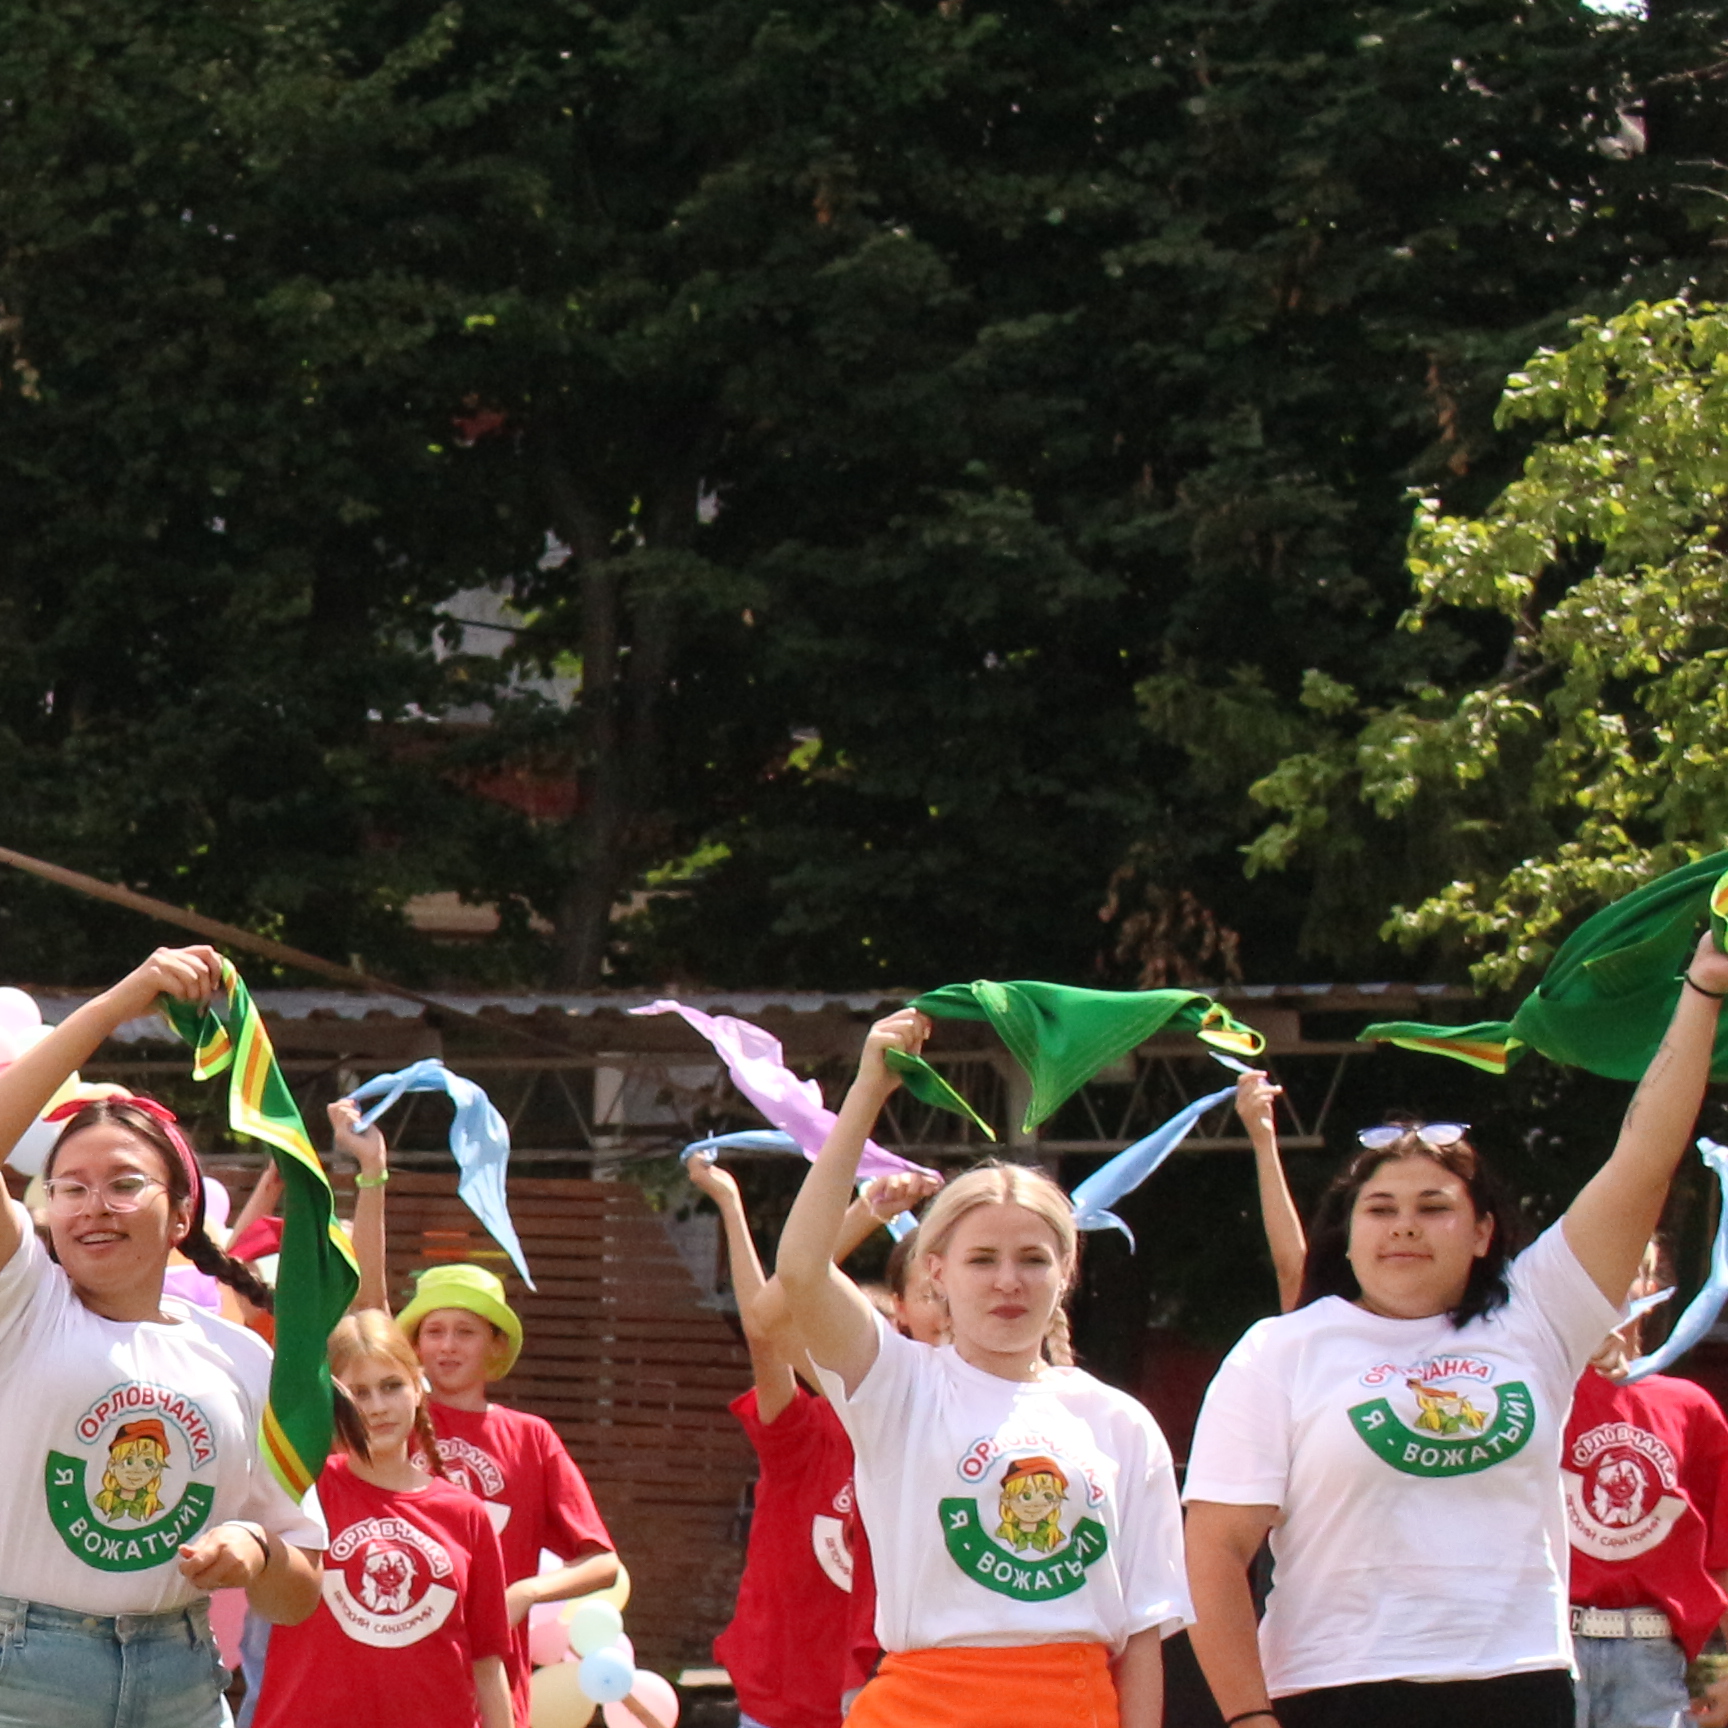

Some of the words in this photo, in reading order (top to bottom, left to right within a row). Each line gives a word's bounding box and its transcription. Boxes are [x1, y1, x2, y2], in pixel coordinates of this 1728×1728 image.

[80, 1386, 211, 1463] ОРЛОВЧАНКА
[1361, 1410, 1386, 1431] Я
[1402, 1391, 1528, 1468] ВОЖАТЫЙ!
[54, 1468, 74, 1486] Я
[68, 1494, 205, 1561] ВОЖАТЫЙ!
[949, 1510, 970, 1529] Я
